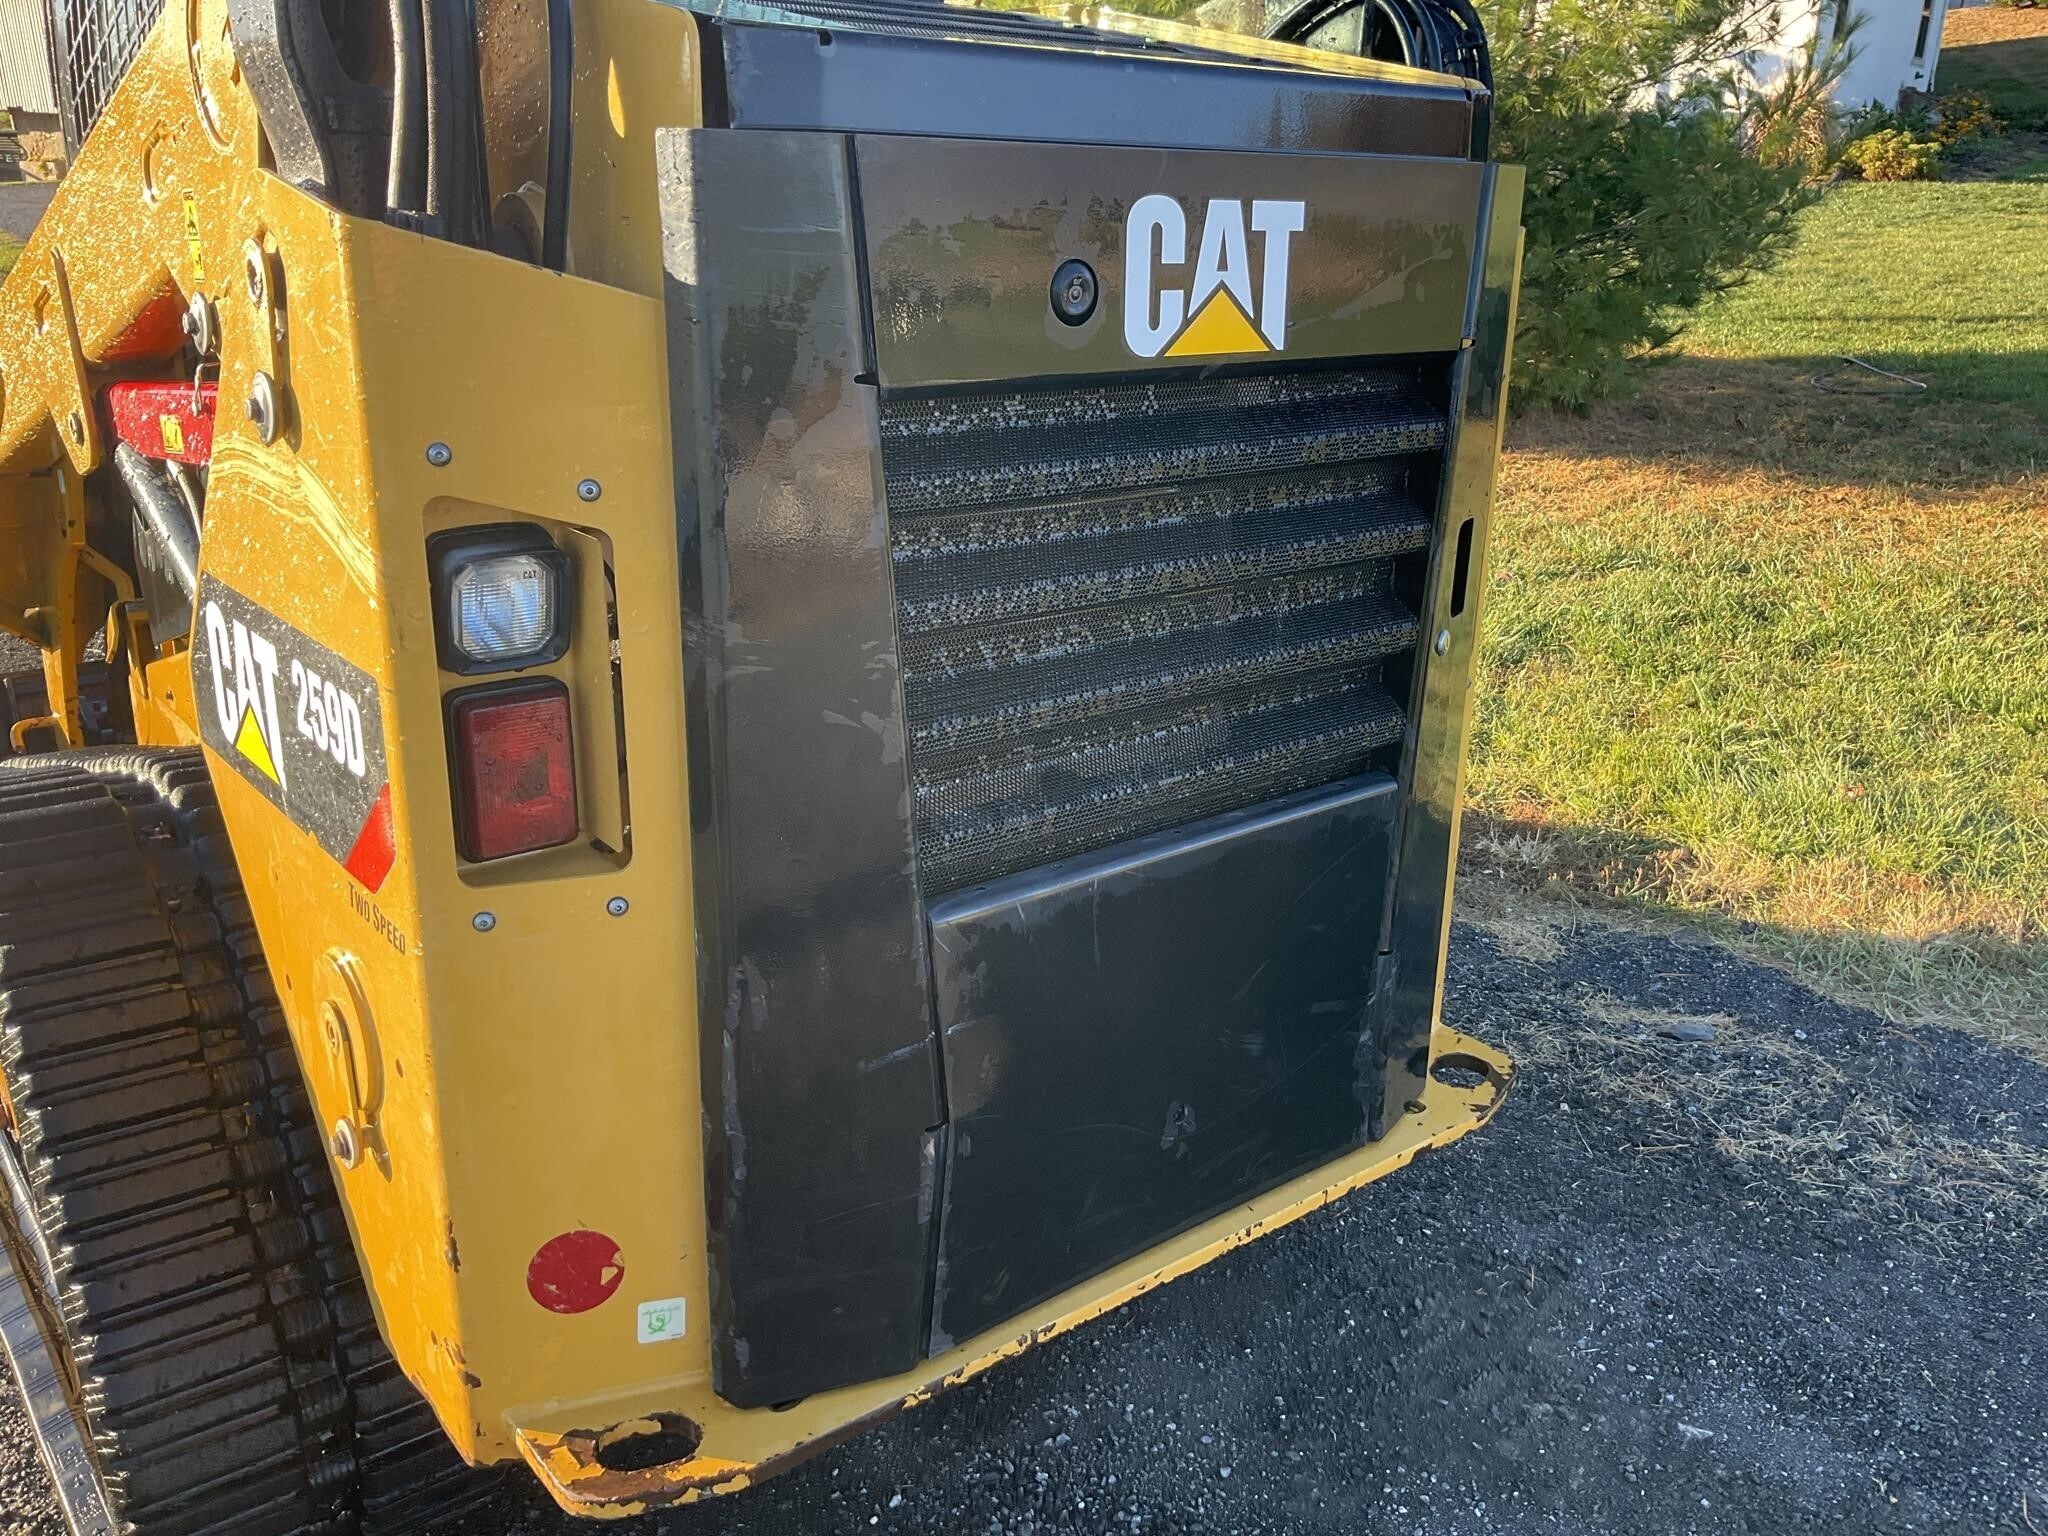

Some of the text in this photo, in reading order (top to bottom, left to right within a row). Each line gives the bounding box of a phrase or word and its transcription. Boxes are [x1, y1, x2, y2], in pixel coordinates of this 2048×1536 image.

[1124, 194, 1306, 358] CAT
[205, 600, 366, 792] CAT 259D
[347, 880, 406, 956] TWO SPEED
